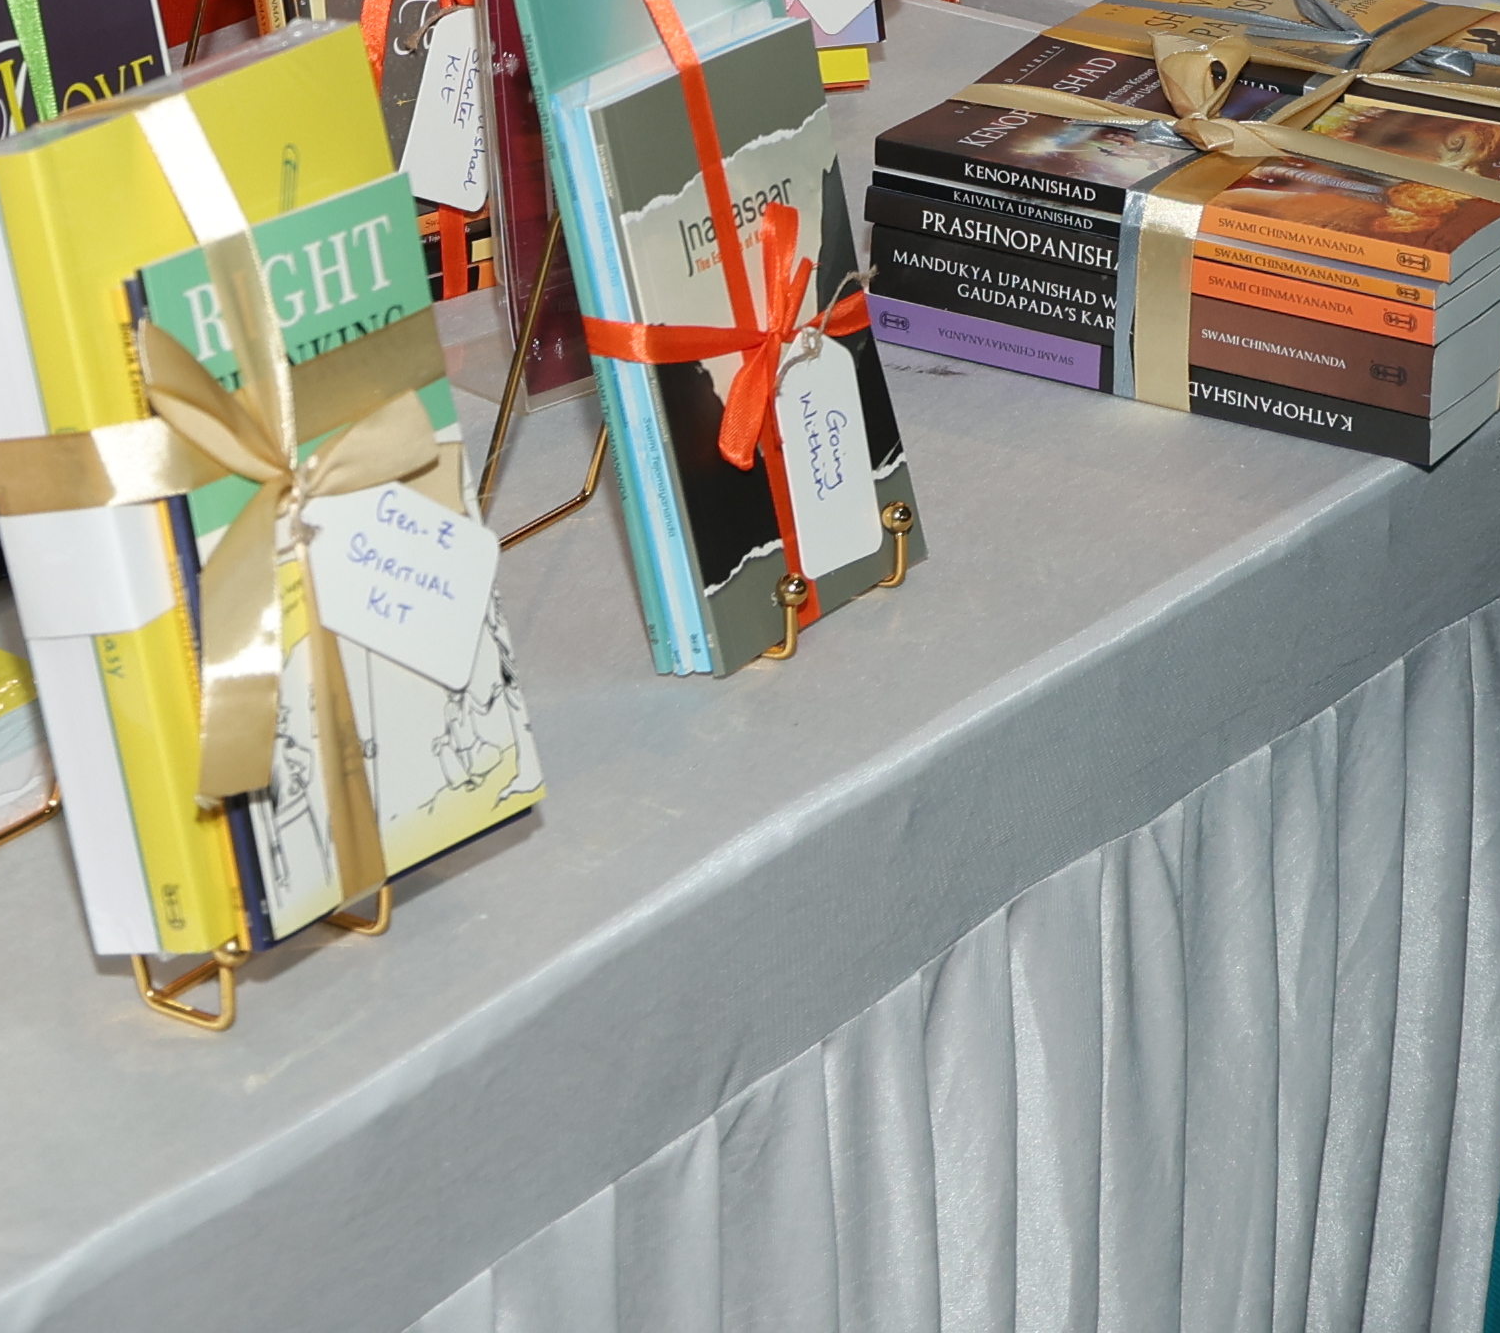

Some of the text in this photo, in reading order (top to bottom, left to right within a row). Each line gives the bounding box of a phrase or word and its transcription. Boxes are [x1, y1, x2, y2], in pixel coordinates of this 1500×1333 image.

[440, 54, 462, 104] Kit
[963, 162, 1097, 203] KENOPANISHAD
[678, 177, 794, 278] Jnaasaar
[952, 189, 1094, 231] KAIVALYA UPANISHAD
[1217, 217, 1366, 257] SWAMI CHINMAYANANDA
[892, 248, 1098, 306] MANDUKYA UPANISHAD
[1213, 247, 1361, 287] SWAMI CHINMAYANANDA
[955, 283, 1078, 322] GAUDAPADA'S
[1207, 274, 1354, 317] SWAMI CHINMAYANANDA
[937, 326, 1075, 367] SWAMI CHINMAYANANDA
[1200, 327, 1347, 371] SWAMI CHINMAYANANDA
[1188, 379, 1354, 433] KATHOPANISHAD
[600, 404, 628, 502] TEJOMAYANANDA
[798, 389, 826, 502] Within
[825, 408, 848, 491] Going
[346, 532, 458, 603] SPIRITUAL
[365, 583, 416, 626] KIT
